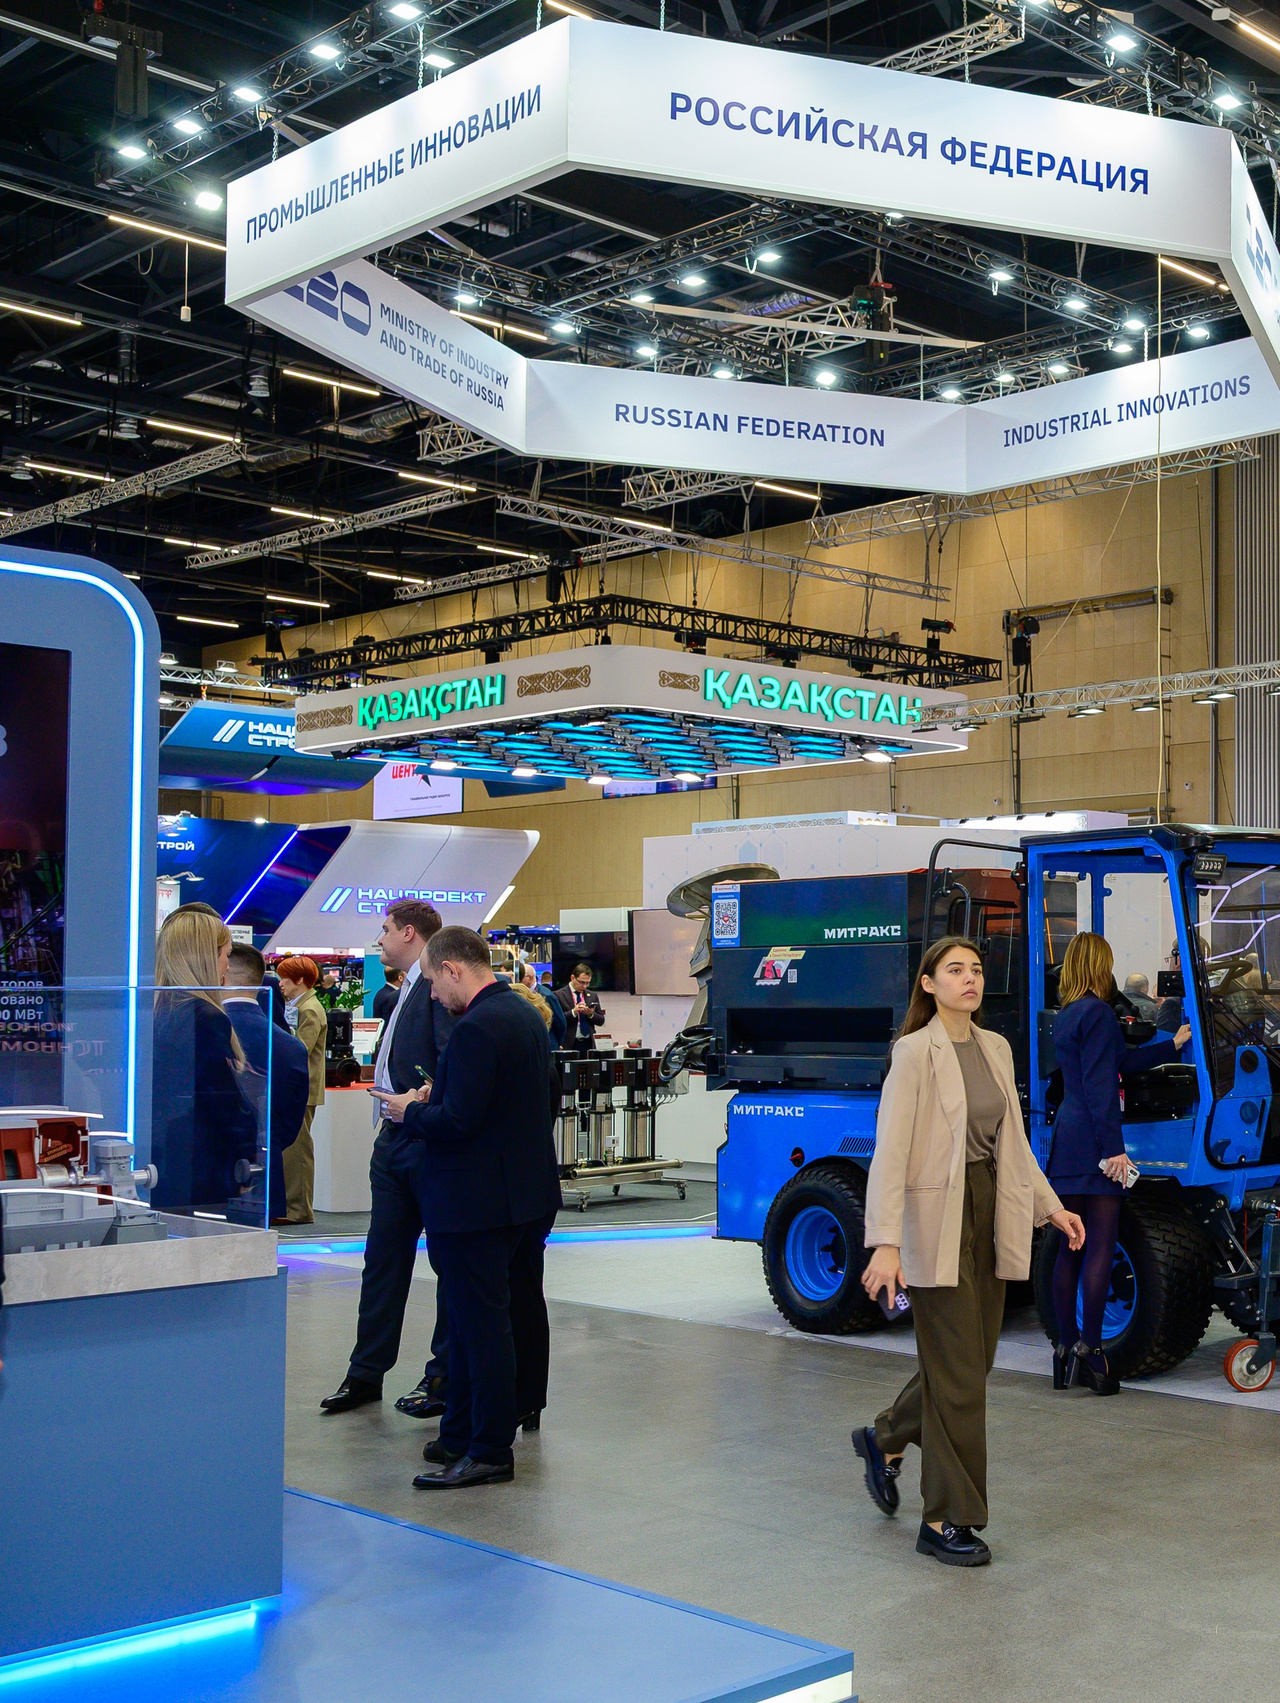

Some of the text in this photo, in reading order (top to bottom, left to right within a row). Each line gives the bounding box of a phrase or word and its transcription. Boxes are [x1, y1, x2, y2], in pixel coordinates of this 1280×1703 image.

[246, 84, 541, 244] ПРОМЫШЛЕННЫЕ ИННОВАЦИИ
[670, 91, 1149, 195] РОССИЙСКАЯ ФЕДЕРАЦИЯ
[380, 302, 509, 390] MINISTRY OF INDUSTRY
[380, 329, 504, 411] AND TRADE OF RUSSIA
[614, 403, 886, 448] RUSSIAN FEDERATION
[1003, 374, 1251, 448] INDUSTRIAL INNOVATIONS
[358, 673, 506, 731] ҚАЗАҚСТАН
[704, 668, 922, 726] ҚАЗАҚСТАН
[391, 764, 418, 779] ЦЕНТ
[157, 841, 194, 851] ТРОЙ
[823, 925, 901, 940] МИТРАКС
[15, 1009, 44, 1020] МВт
[733, 1104, 804, 1117] МИТРАКС
